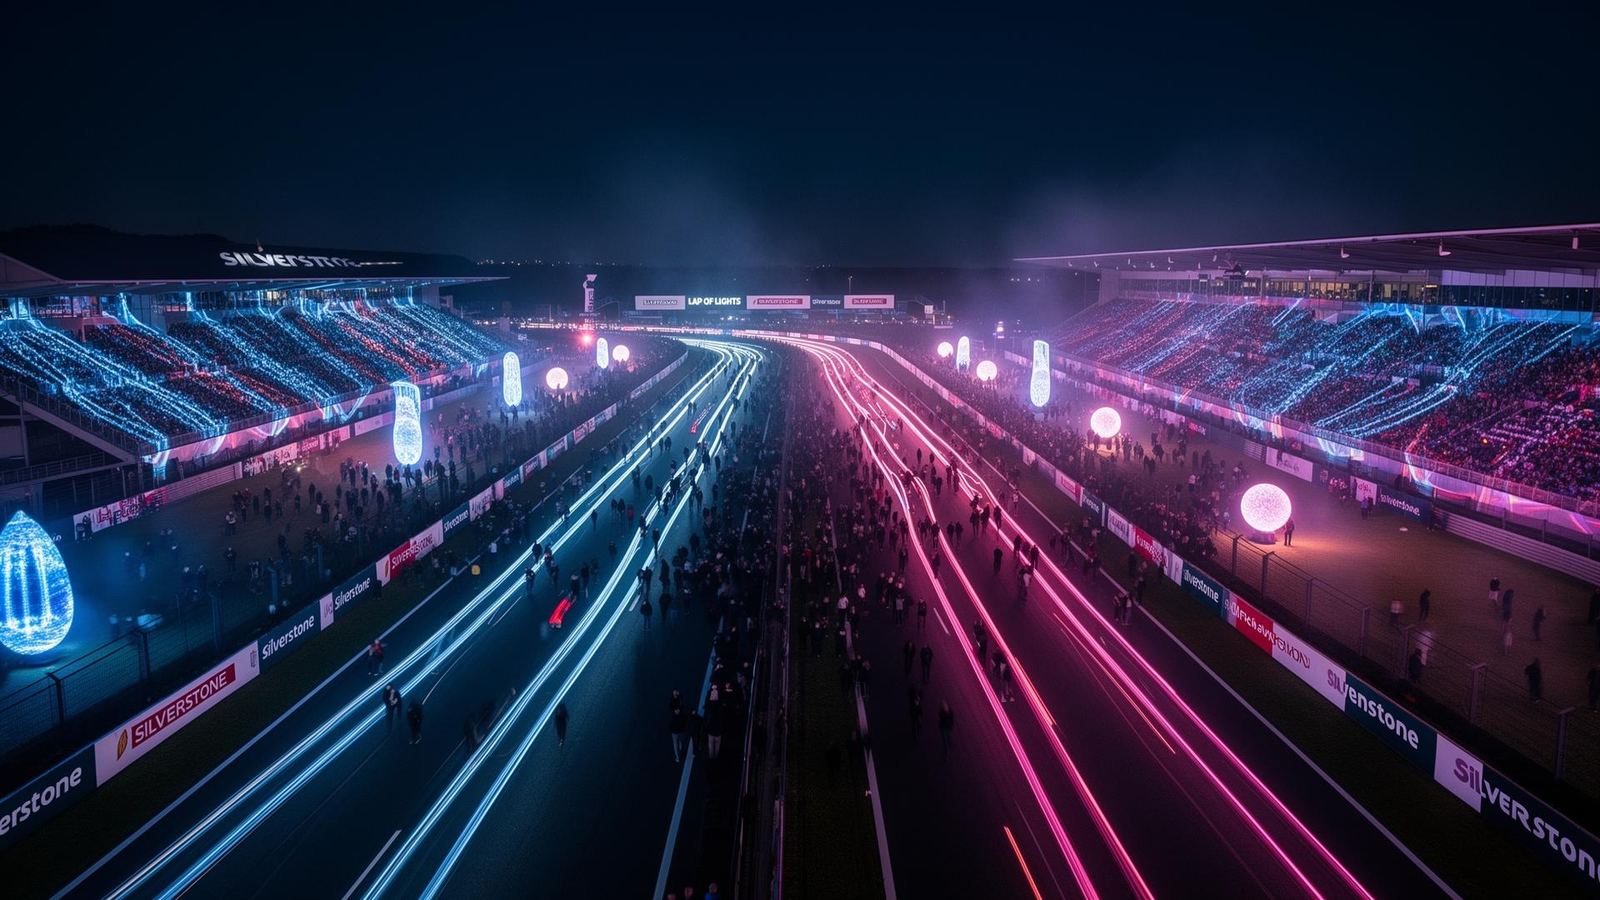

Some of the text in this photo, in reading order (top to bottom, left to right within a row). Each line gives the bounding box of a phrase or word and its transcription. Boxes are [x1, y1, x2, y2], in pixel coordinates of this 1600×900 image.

[688, 297, 741, 306] LAP OF LIGHTS
[262, 615, 315, 660] Silverstone
[135, 671, 227, 743] SILVERSTONE
